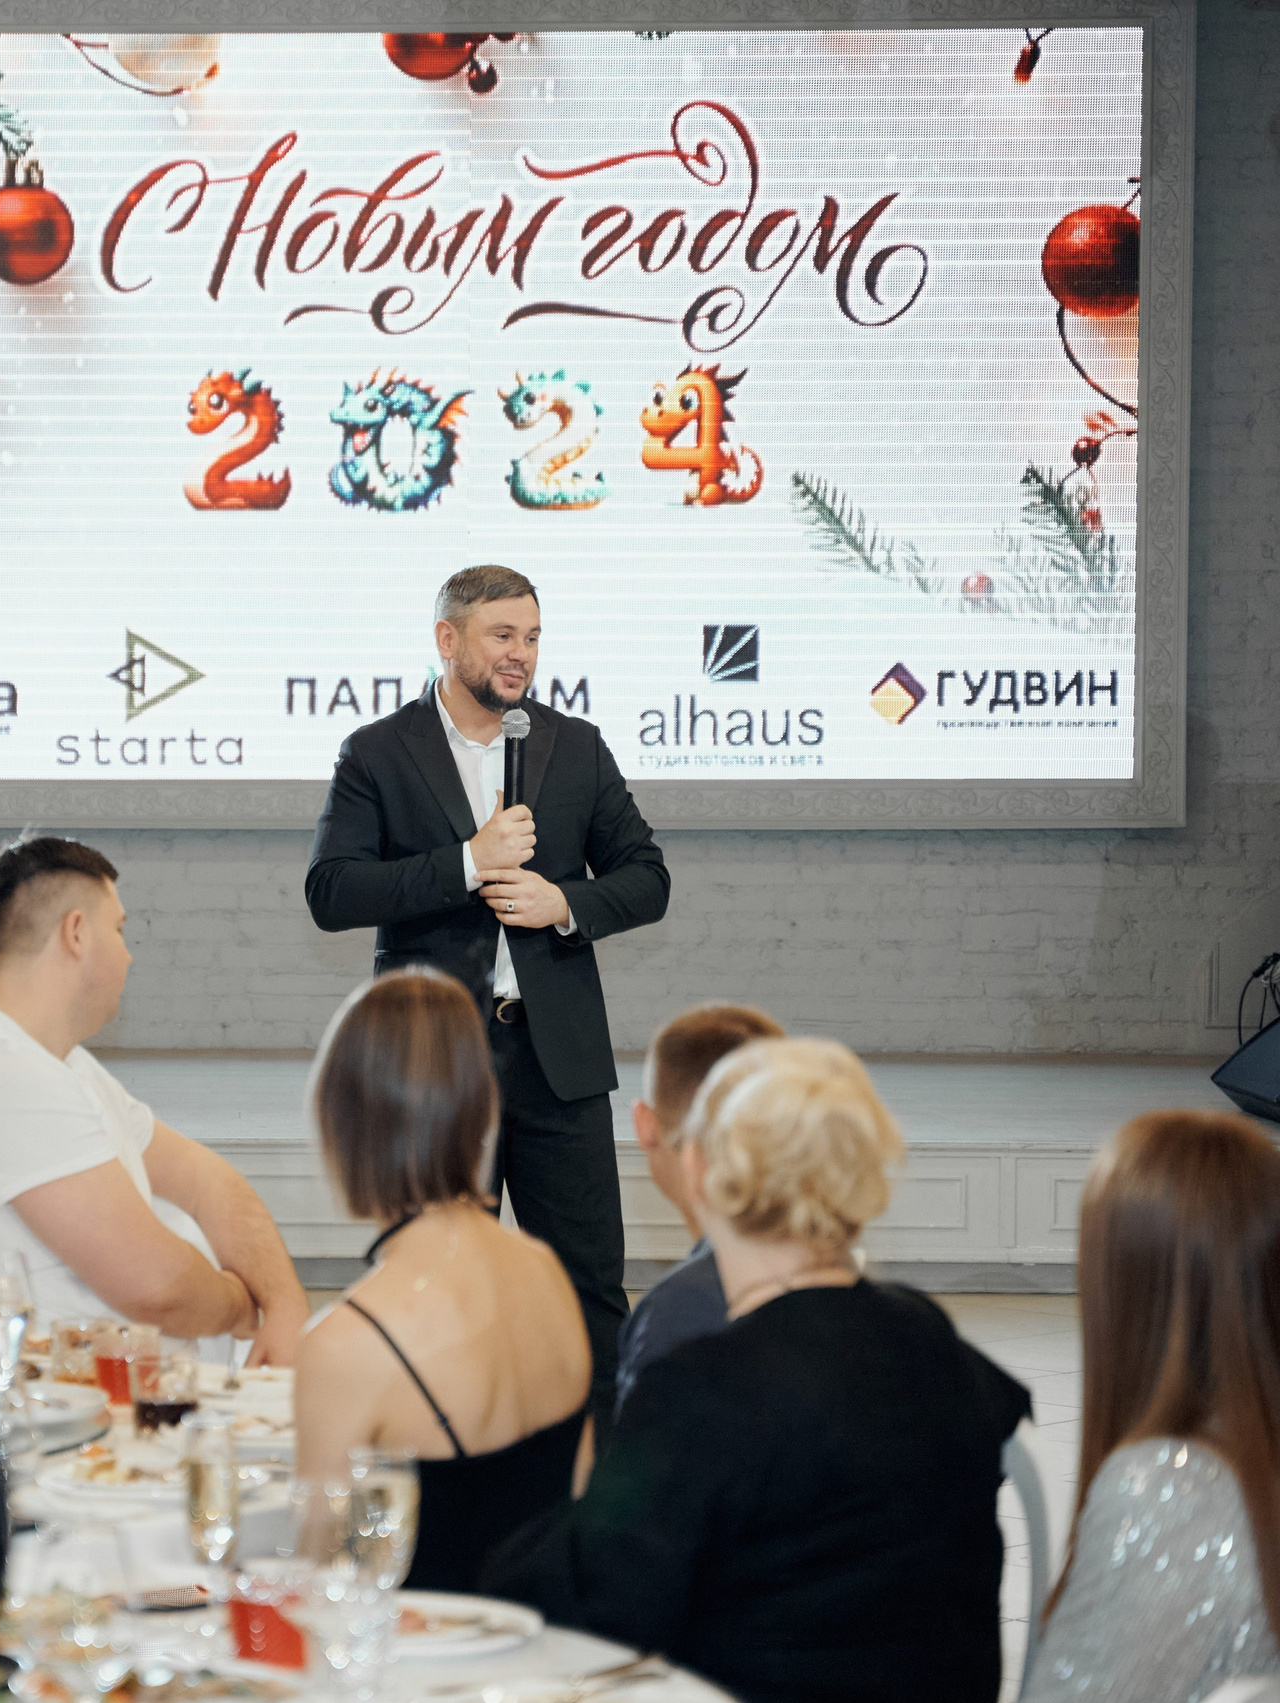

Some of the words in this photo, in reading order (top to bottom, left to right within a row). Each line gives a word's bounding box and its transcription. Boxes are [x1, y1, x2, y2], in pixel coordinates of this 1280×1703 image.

[100, 158, 208, 292] С
[208, 132, 566, 334] Новым
[503, 100, 929, 353] годом
[183, 362, 764, 513] 2024
[286, 675, 590, 716] ПАПМ
[937, 670, 1119, 714] ГУДВИН
[639, 694, 825, 747] alhaus
[56, 728, 243, 766] starta
